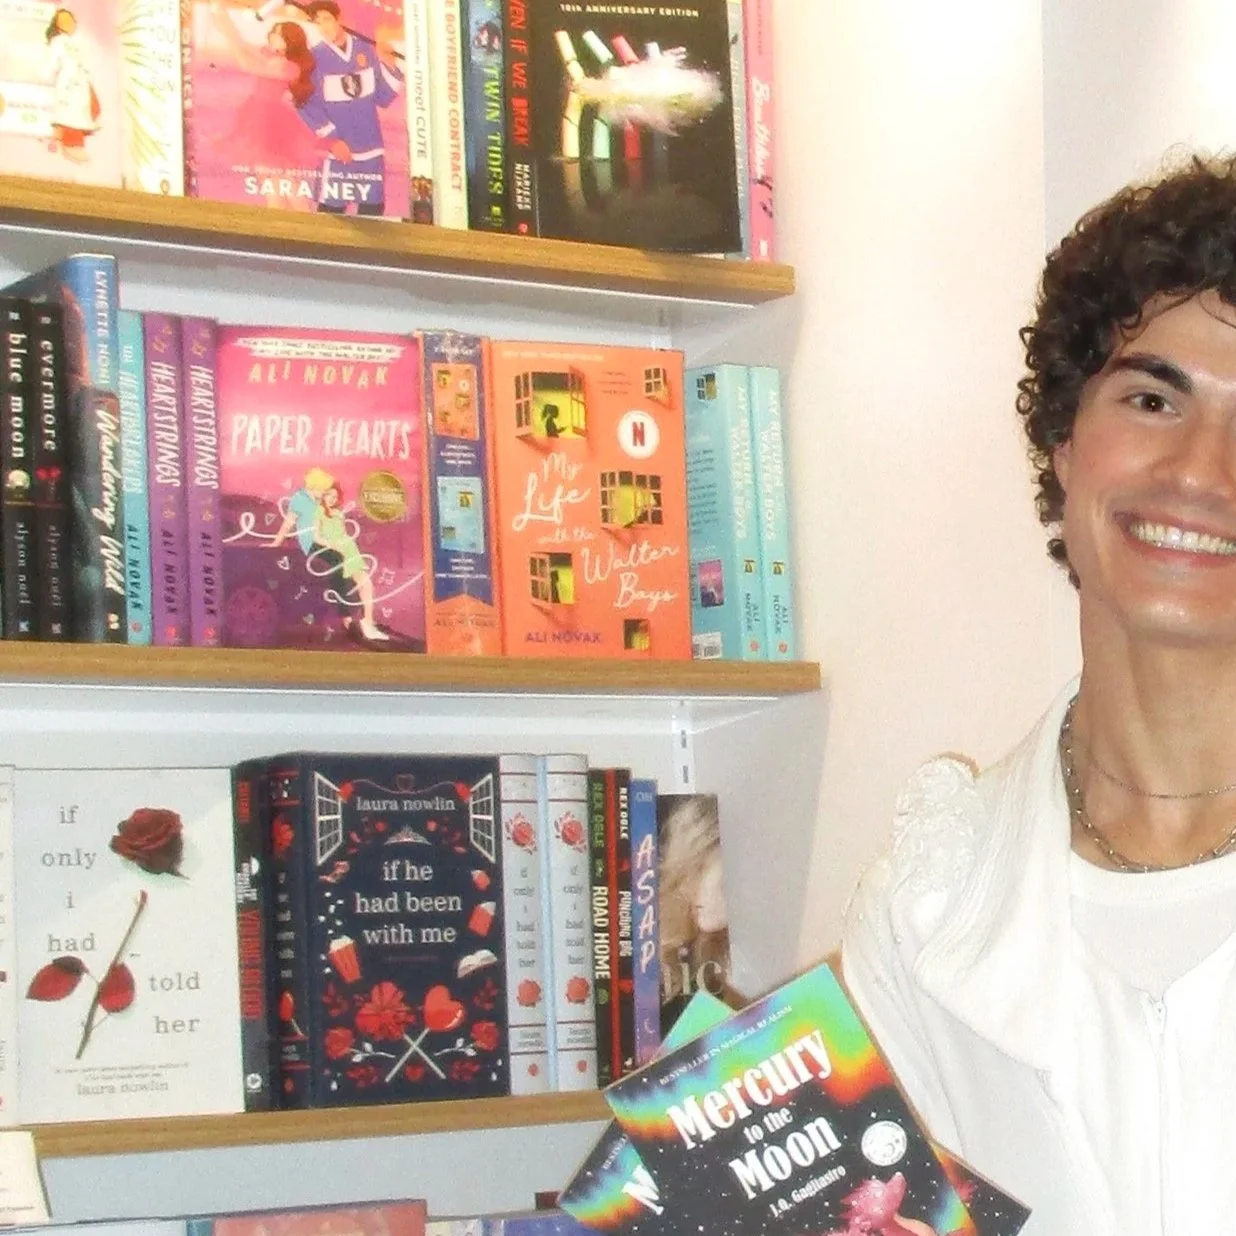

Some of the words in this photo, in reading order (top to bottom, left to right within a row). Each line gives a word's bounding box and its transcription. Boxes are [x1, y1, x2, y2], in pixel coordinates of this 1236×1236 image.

[586, 5, 655, 15] ANNIVERSARY
[659, 8, 699, 18] EDITION
[244, 177, 312, 199] SARA
[322, 182, 371, 201] NEY
[8, 333, 28, 383] blue
[248, 362, 290, 385] ALI
[303, 364, 390, 390] NOVAK
[10, 396, 25, 459] moon
[149, 362, 180, 488] HEARTSTRINGS
[230, 414, 316, 458] PAPER
[324, 416, 412, 460] HEARTS
[512, 472, 591, 532] Life
[581, 541, 681, 585] Walter
[613, 573, 676, 612] Boys
[59, 806, 79, 824] if
[356, 797, 398, 812] laura
[402, 796, 456, 811] nowlin
[41, 849, 97, 870] only
[382, 860, 402, 881] if
[404, 861, 434, 881] he
[355, 893, 398, 913] had
[403, 892, 462, 912] been
[592, 885, 609, 928] ROAD
[48, 933, 97, 952] had
[363, 924, 417, 945] with
[420, 925, 457, 943] me
[594, 931, 611, 980] HOME
[149, 972, 200, 991] told
[154, 1016, 200, 1034] her
[665, 1026, 834, 1151] Mercury
[743, 1123, 765, 1145] to
[762, 1102, 793, 1134] the
[728, 1114, 843, 1201] Moon
[769, 1193, 793, 1219] J.Q.
[791, 1165, 847, 1206] Gagliastro
